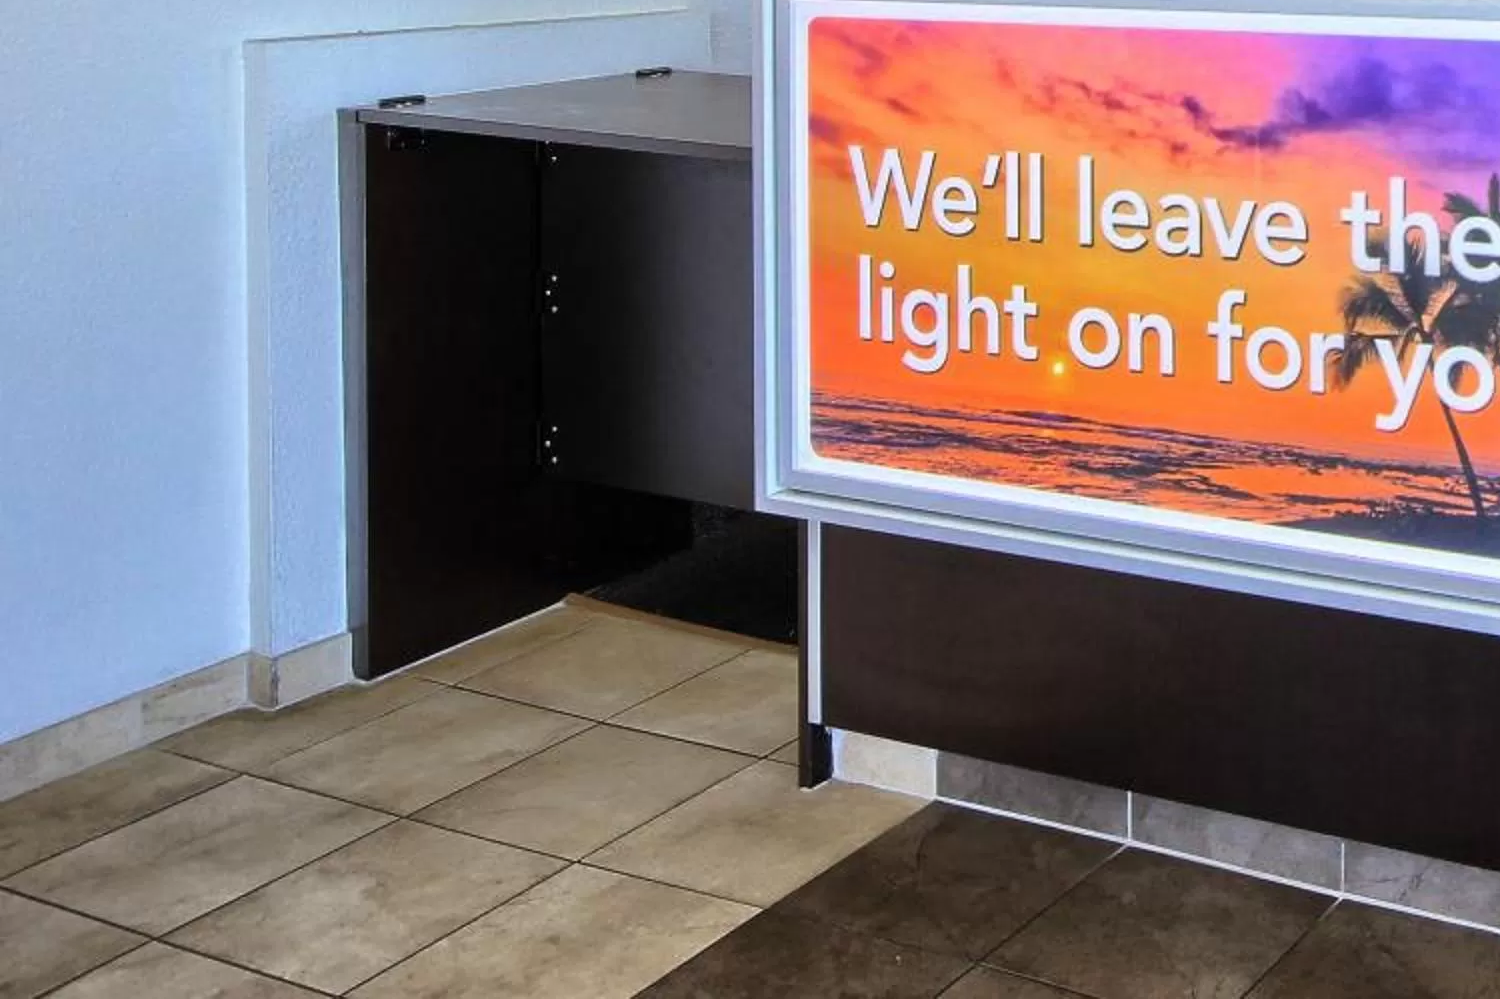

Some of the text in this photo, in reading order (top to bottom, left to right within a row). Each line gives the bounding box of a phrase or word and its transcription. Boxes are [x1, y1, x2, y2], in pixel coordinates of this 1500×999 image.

[849, 145, 1044, 241] We'll
[1079, 155, 1308, 266] leave
[857, 255, 1040, 374] light
[1068, 305, 1175, 376] on
[1207, 291, 1345, 394] for
